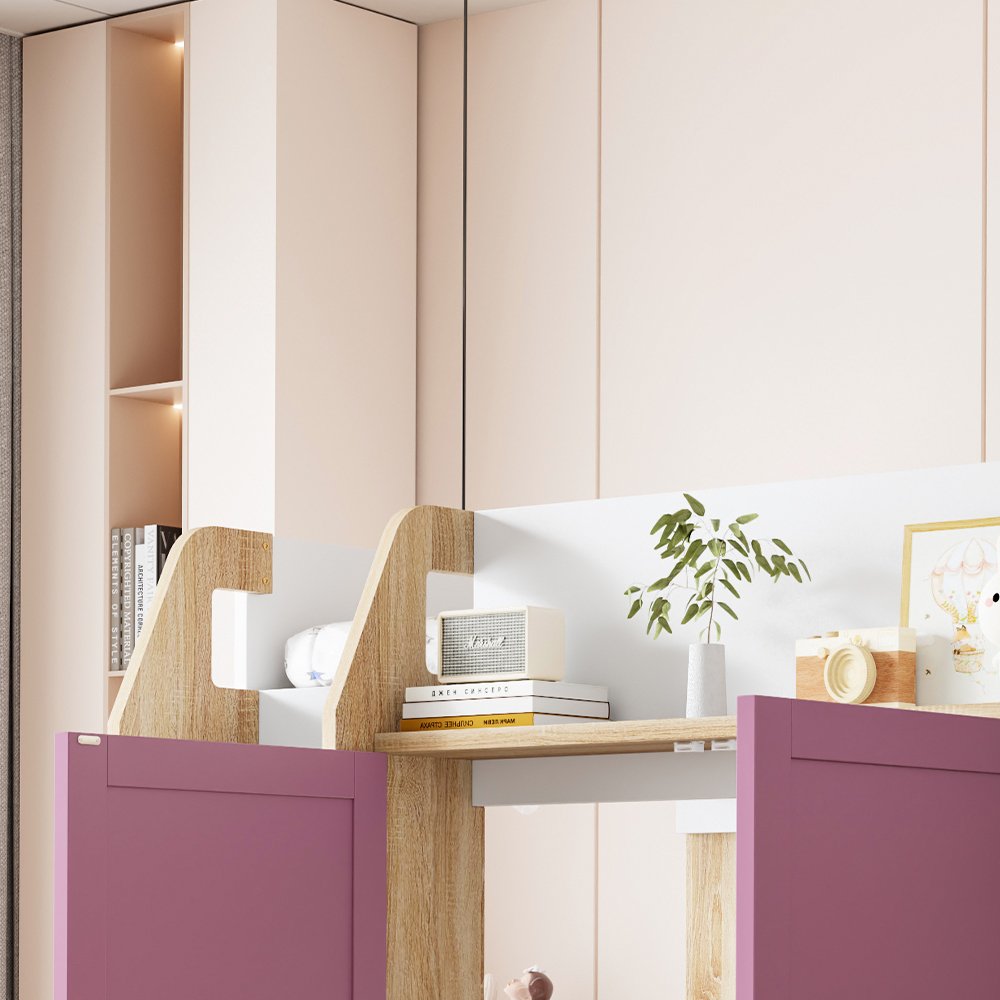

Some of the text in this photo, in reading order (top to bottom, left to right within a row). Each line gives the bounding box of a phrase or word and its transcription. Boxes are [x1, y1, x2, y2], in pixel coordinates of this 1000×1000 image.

[146, 529, 155, 575] VANITY
[111, 534, 119, 664] ELEMENTS OF STYLE
[123, 532, 132, 665] COPYRIGHTED MATERIAL
[431, 689, 457, 697] ДЖЕН
